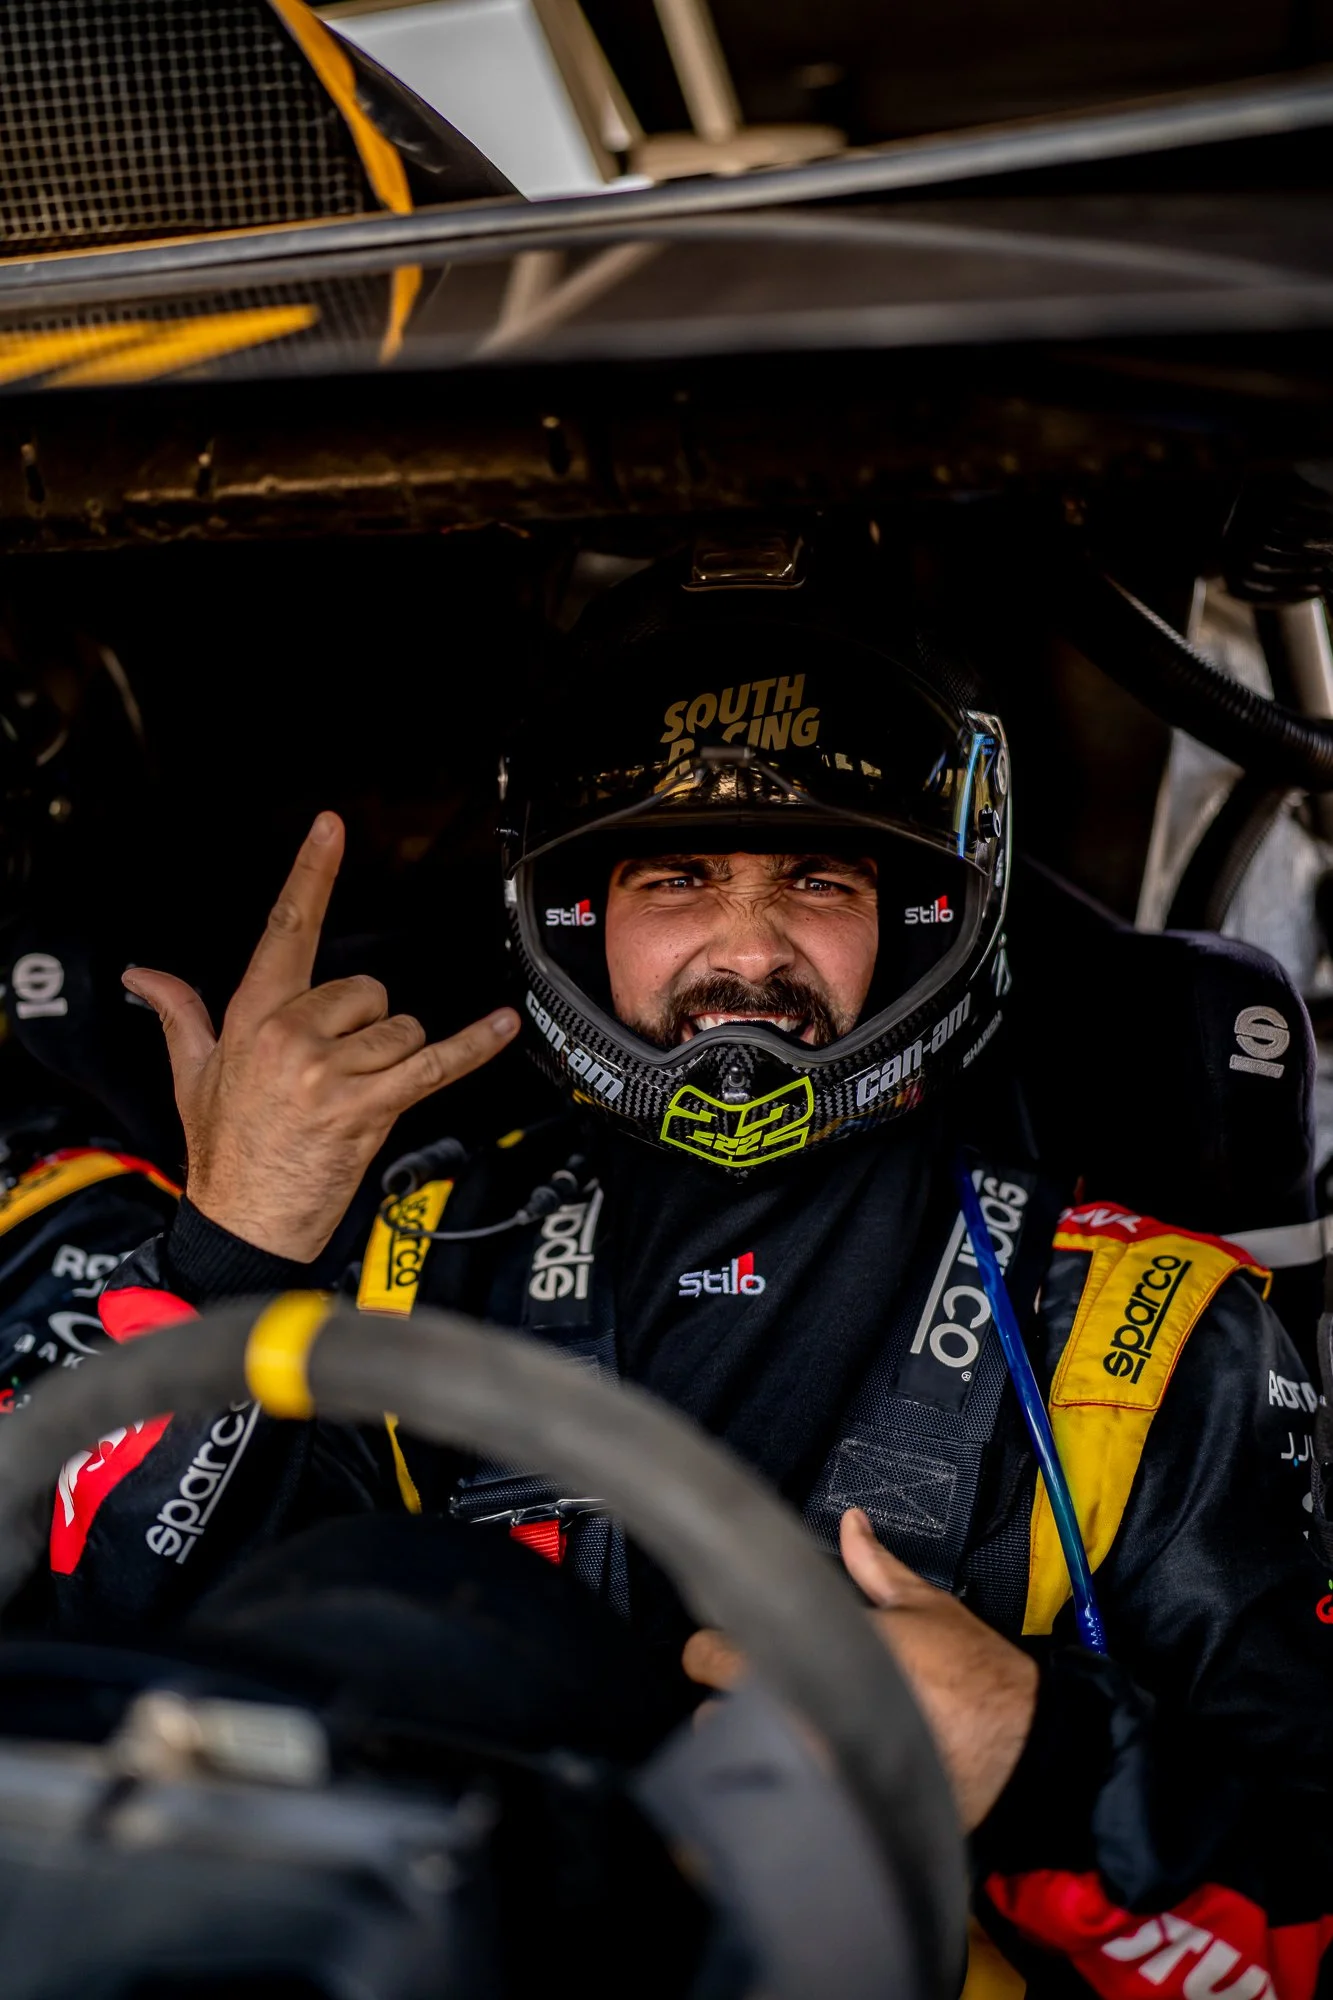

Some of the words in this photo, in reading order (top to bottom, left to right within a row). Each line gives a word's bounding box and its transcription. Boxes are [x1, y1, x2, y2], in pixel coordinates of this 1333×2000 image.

[659, 673, 806, 744] SOUTH
[664, 706, 821, 782] RCING
[1102, 1254, 1192, 1385] sparco
